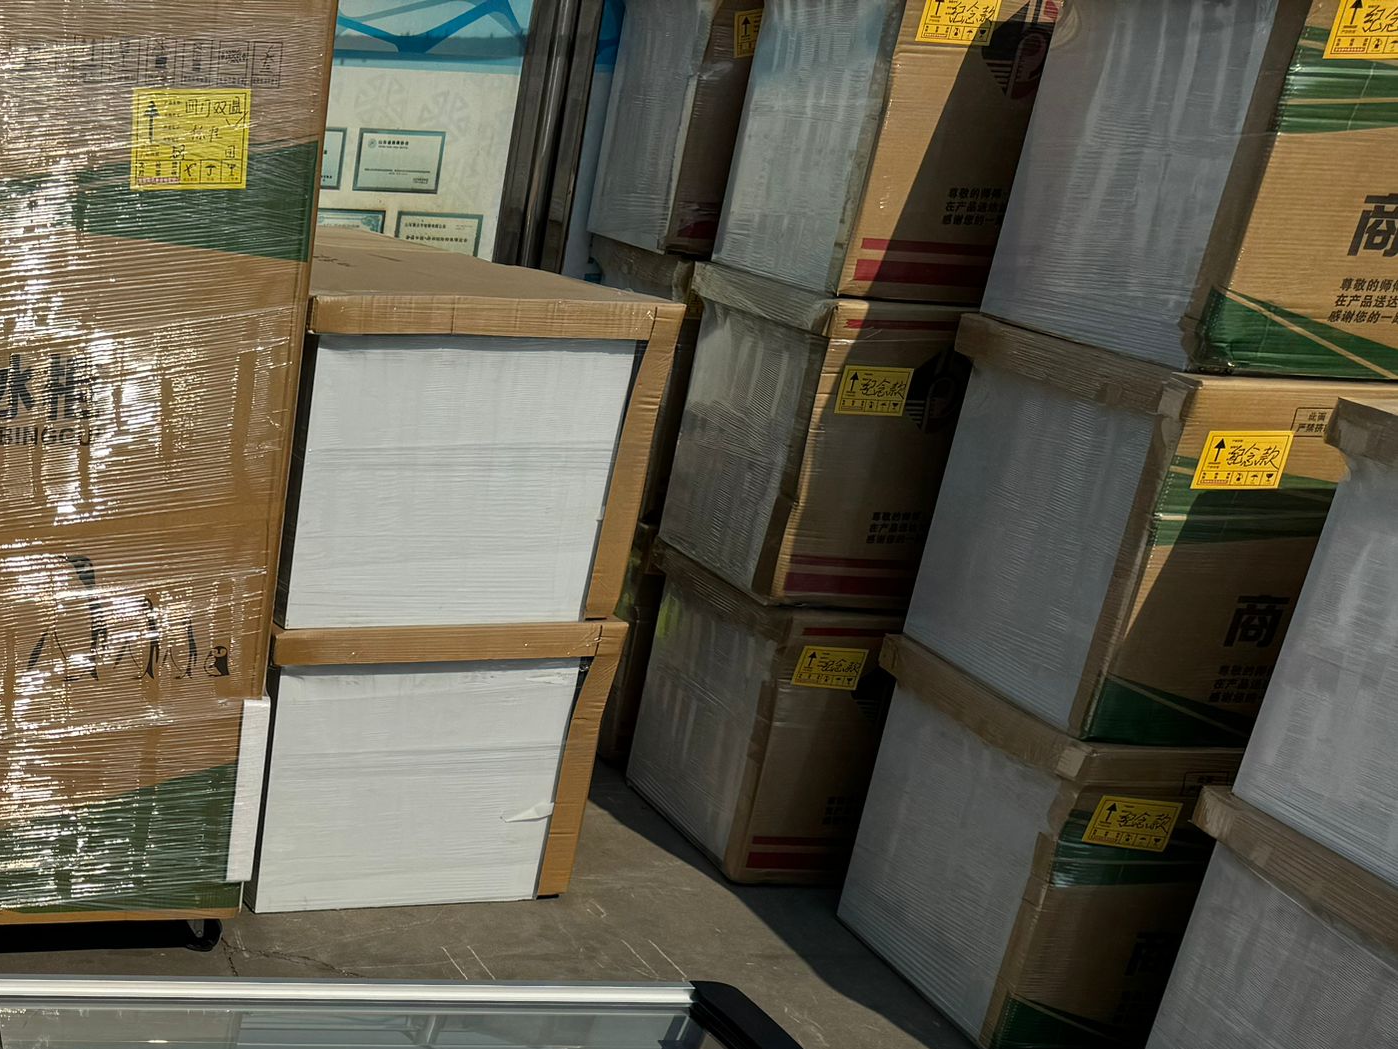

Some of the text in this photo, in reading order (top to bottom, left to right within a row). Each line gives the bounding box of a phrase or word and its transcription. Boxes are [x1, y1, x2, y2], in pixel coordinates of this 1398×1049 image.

[1226, 443, 1280, 470] 纪念款
[1222, 594, 1291, 648] 商
